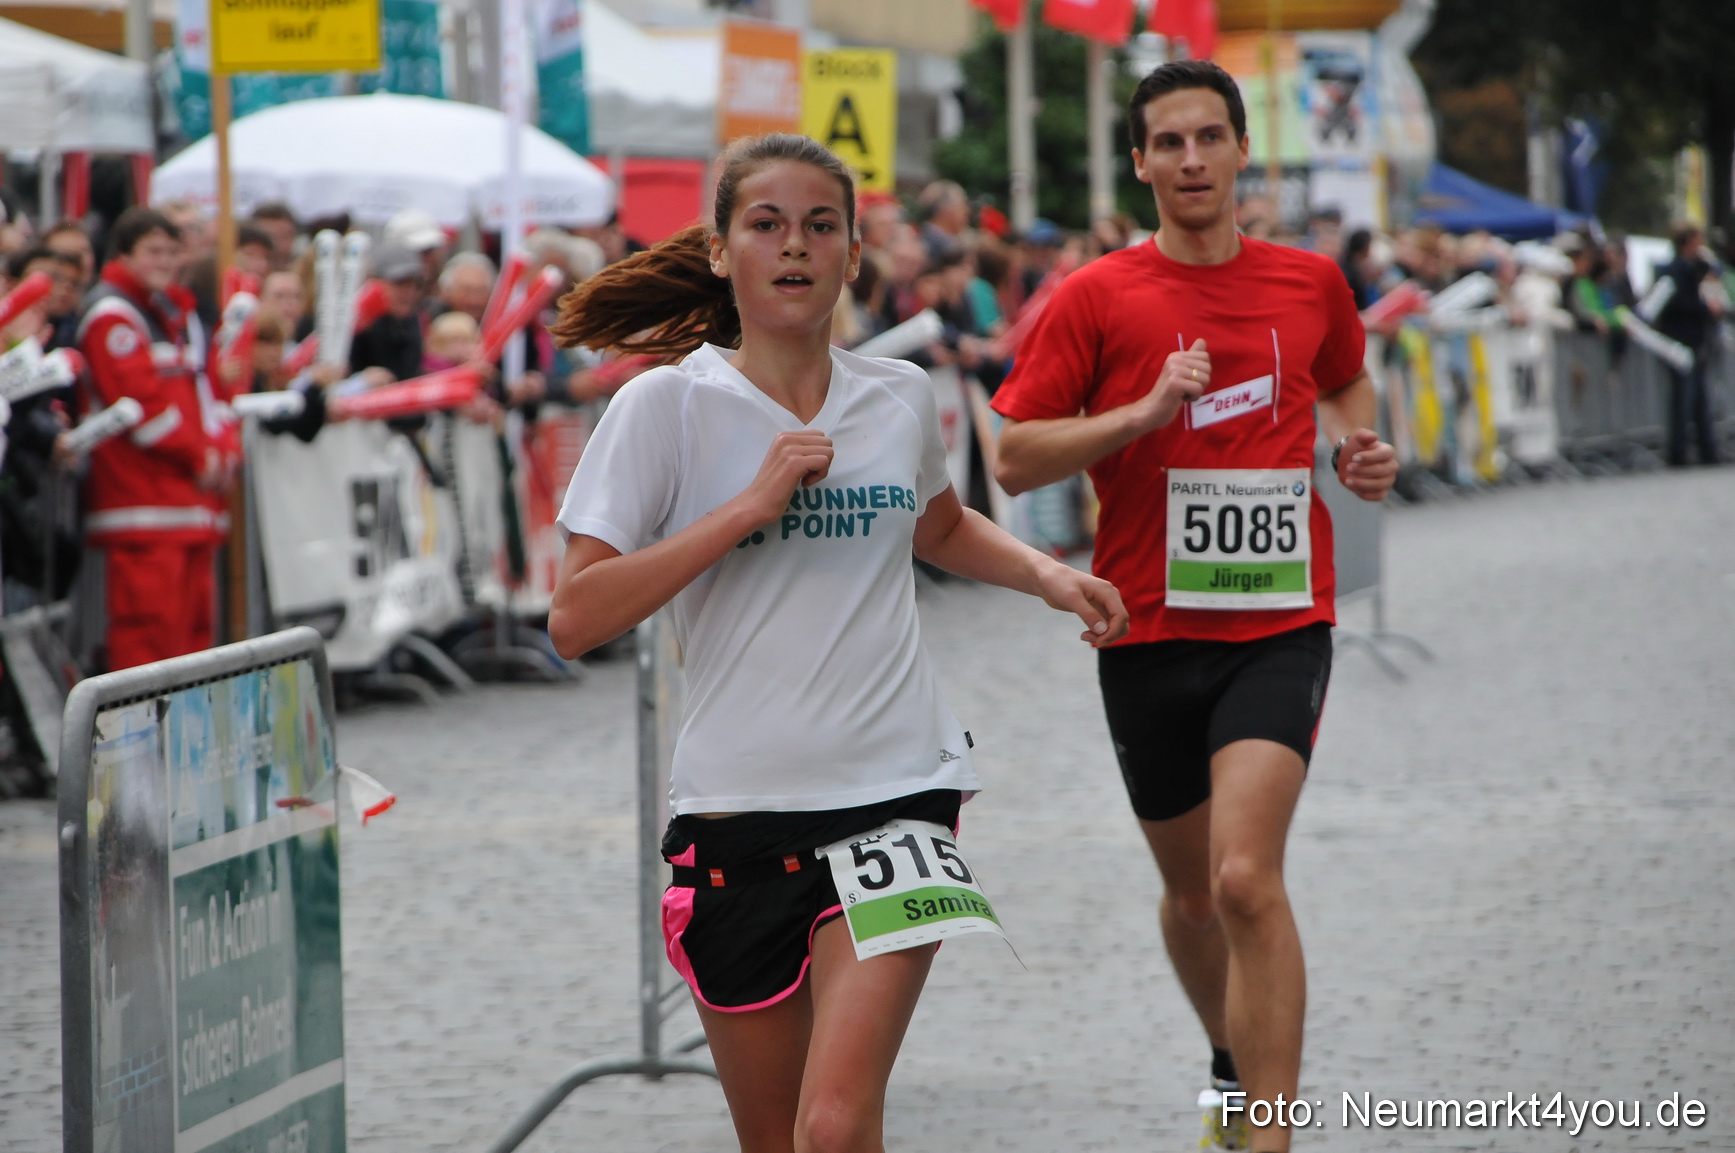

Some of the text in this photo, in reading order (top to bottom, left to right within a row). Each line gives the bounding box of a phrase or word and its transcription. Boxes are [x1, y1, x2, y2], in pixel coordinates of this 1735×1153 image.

[268, 18, 320, 42] lauf
[812, 54, 883, 80] Block
[826, 94, 869, 154] A
[1214, 390, 1252, 413] DEHN
[786, 485, 916, 512] RUNNERS
[1171, 481, 1288, 496] PARTL Neumarkt
[781, 511, 878, 540] POINT
[1183, 503, 1297, 554] 5085
[1209, 568, 1273, 592] Jürgen
[848, 893, 857, 904] S
[902, 893, 994, 921] Samira
[179, 905, 207, 980] Fun
[208, 894, 221, 969] &
[223, 879, 267, 963] Action
[182, 1008, 241, 1095] sicheren
